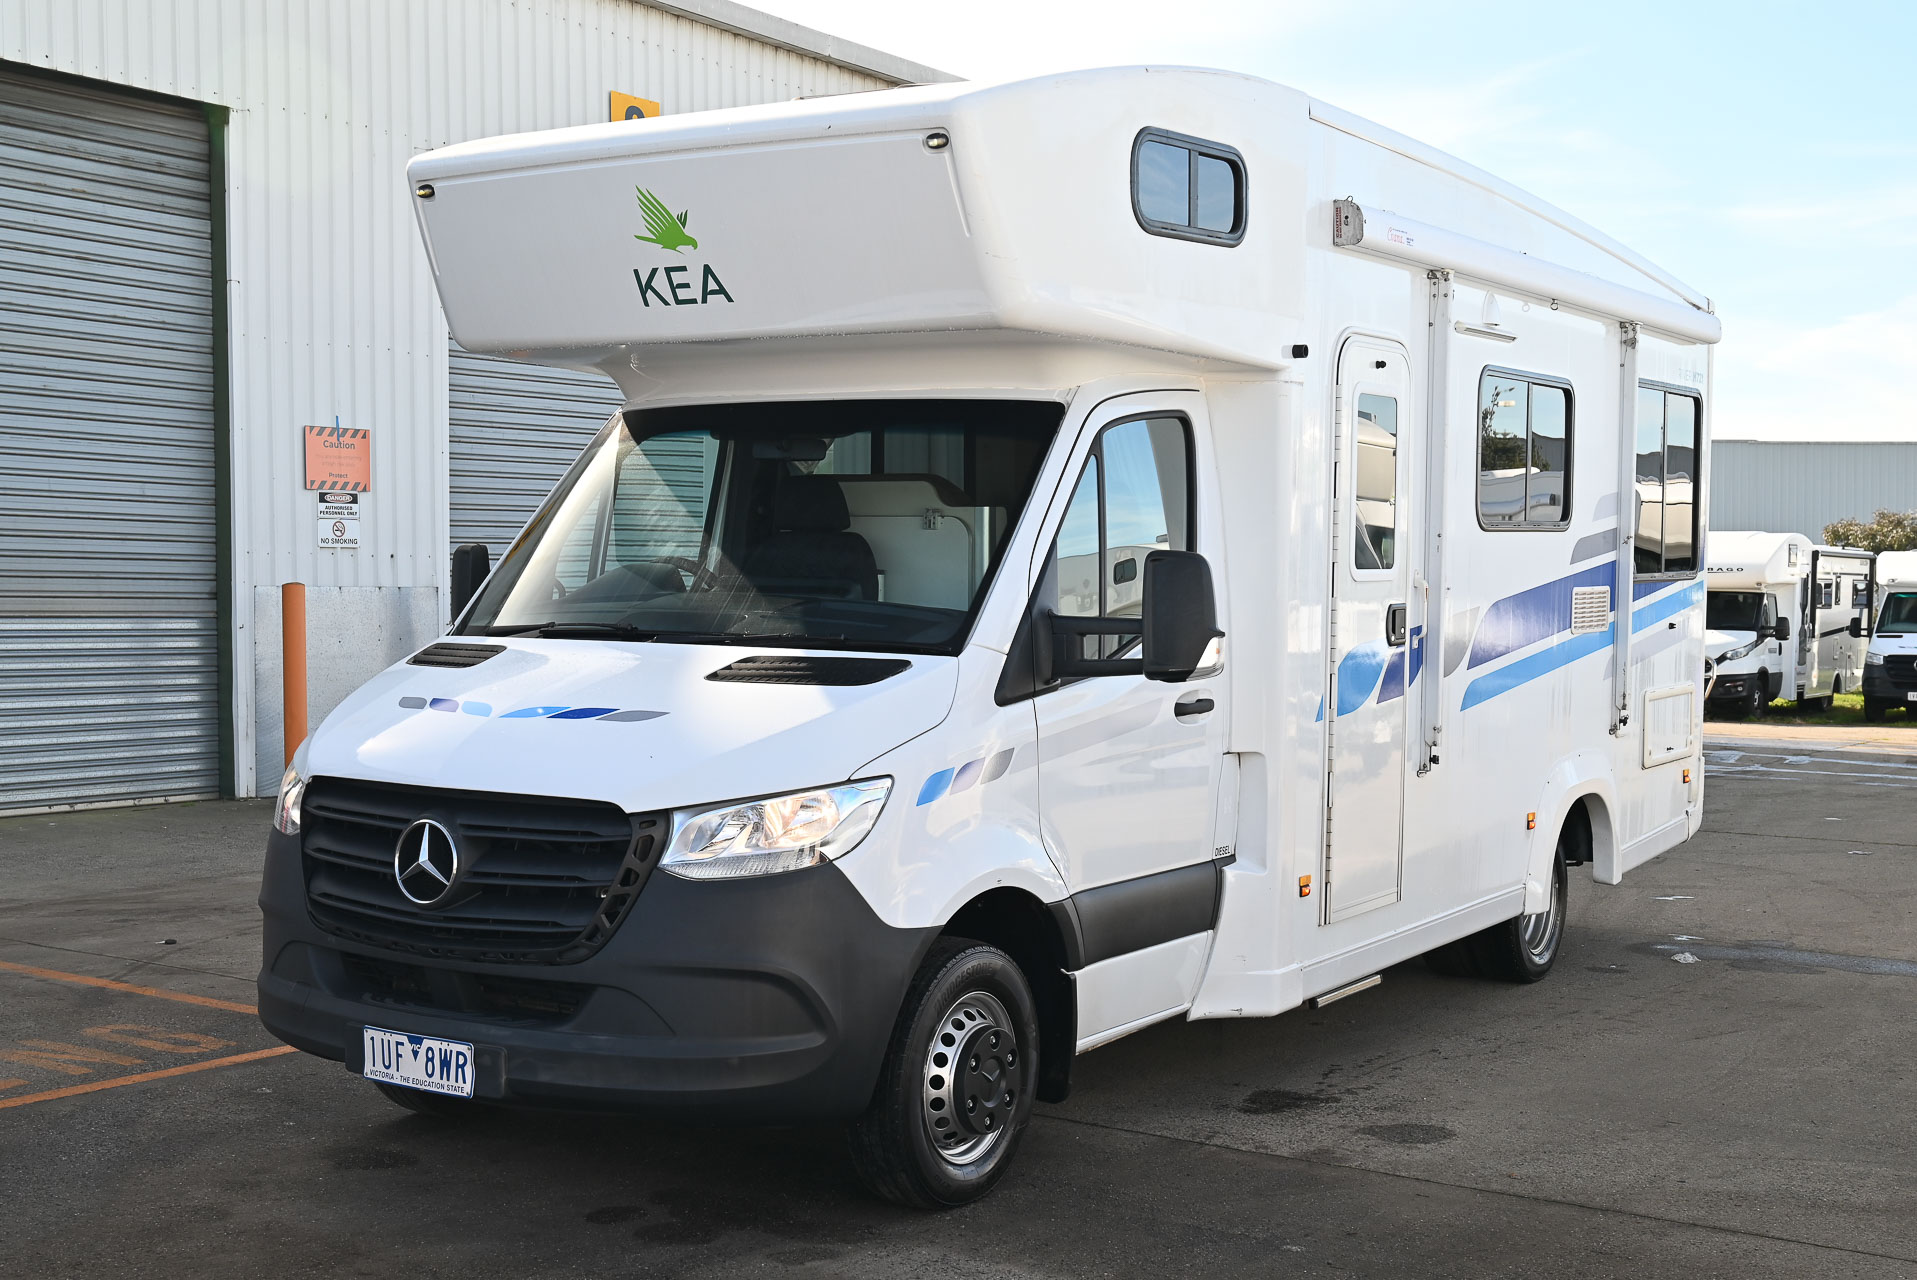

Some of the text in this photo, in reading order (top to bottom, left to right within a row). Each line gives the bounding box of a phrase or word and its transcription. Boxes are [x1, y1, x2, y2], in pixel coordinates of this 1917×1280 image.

[633, 263, 735, 307] KEA
[322, 440, 356, 450] Caution
[1214, 845, 1231, 857] DIESEL
[370, 1036, 468, 1084] 1UF 8WR
[369, 1068, 395, 1081] VICTORIA
[400, 1075, 411, 1084] THE
[411, 1077, 445, 1090] EDUCATION
[446, 1085, 465, 1094] STATE
